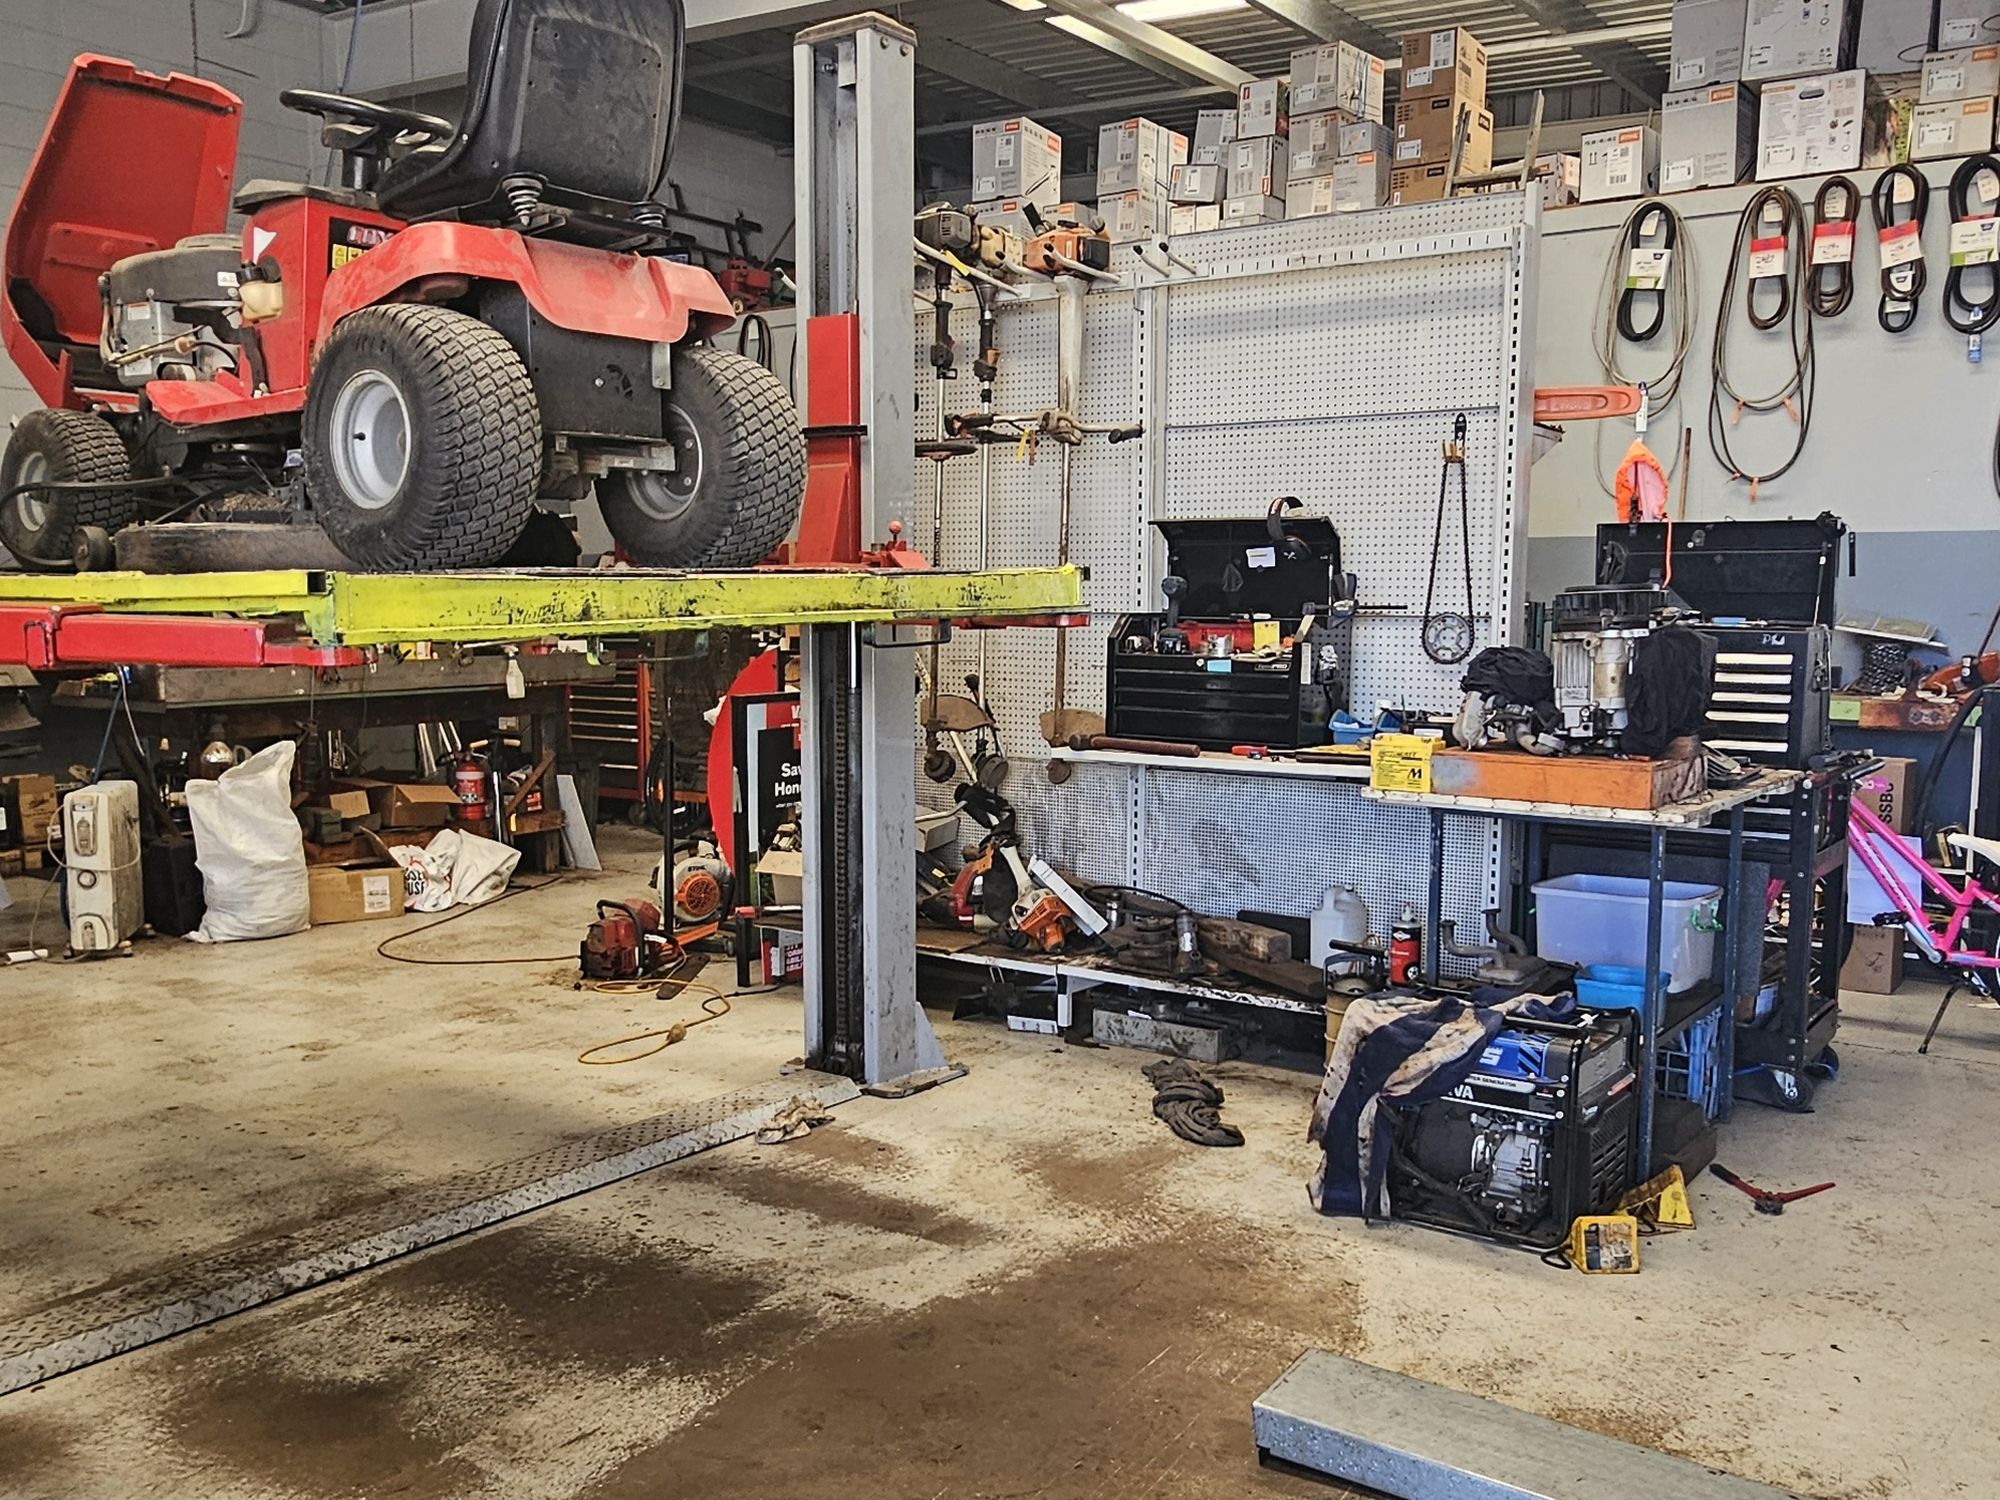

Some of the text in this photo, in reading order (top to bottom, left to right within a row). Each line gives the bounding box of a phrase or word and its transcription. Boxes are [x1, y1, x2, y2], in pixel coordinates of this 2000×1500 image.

[774, 781, 801, 797] Hon
[1482, 1077, 1517, 1088] GENERATOR
[1448, 1084, 1474, 1100] VA
